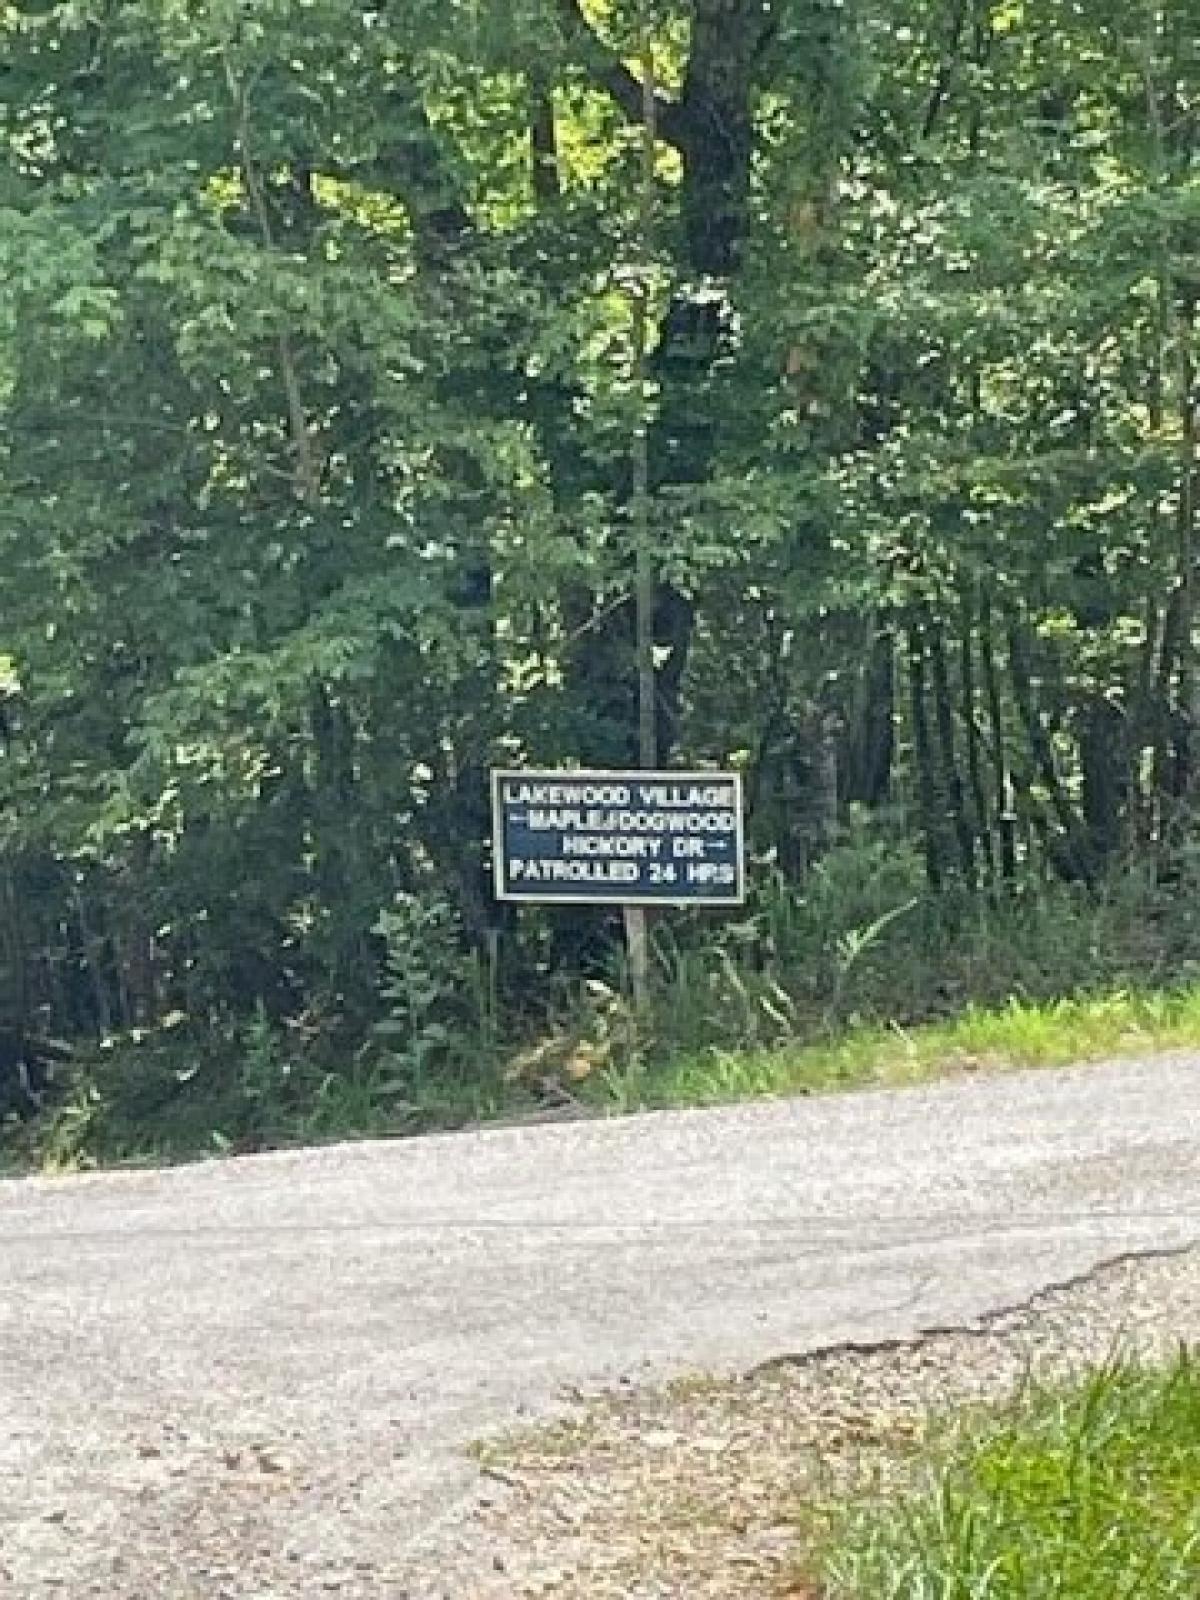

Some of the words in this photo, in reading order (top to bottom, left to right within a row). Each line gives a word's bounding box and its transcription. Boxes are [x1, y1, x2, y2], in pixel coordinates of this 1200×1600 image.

[502, 783, 631, 804] LAKEWOOD
[639, 786, 734, 807] VILLAGE
[562, 836, 662, 857] HICKORY
[672, 839, 704, 858] DR
[509, 858, 641, 881] PATROLLED
[649, 861, 677, 884] 24
[686, 862, 735, 884] HRS
